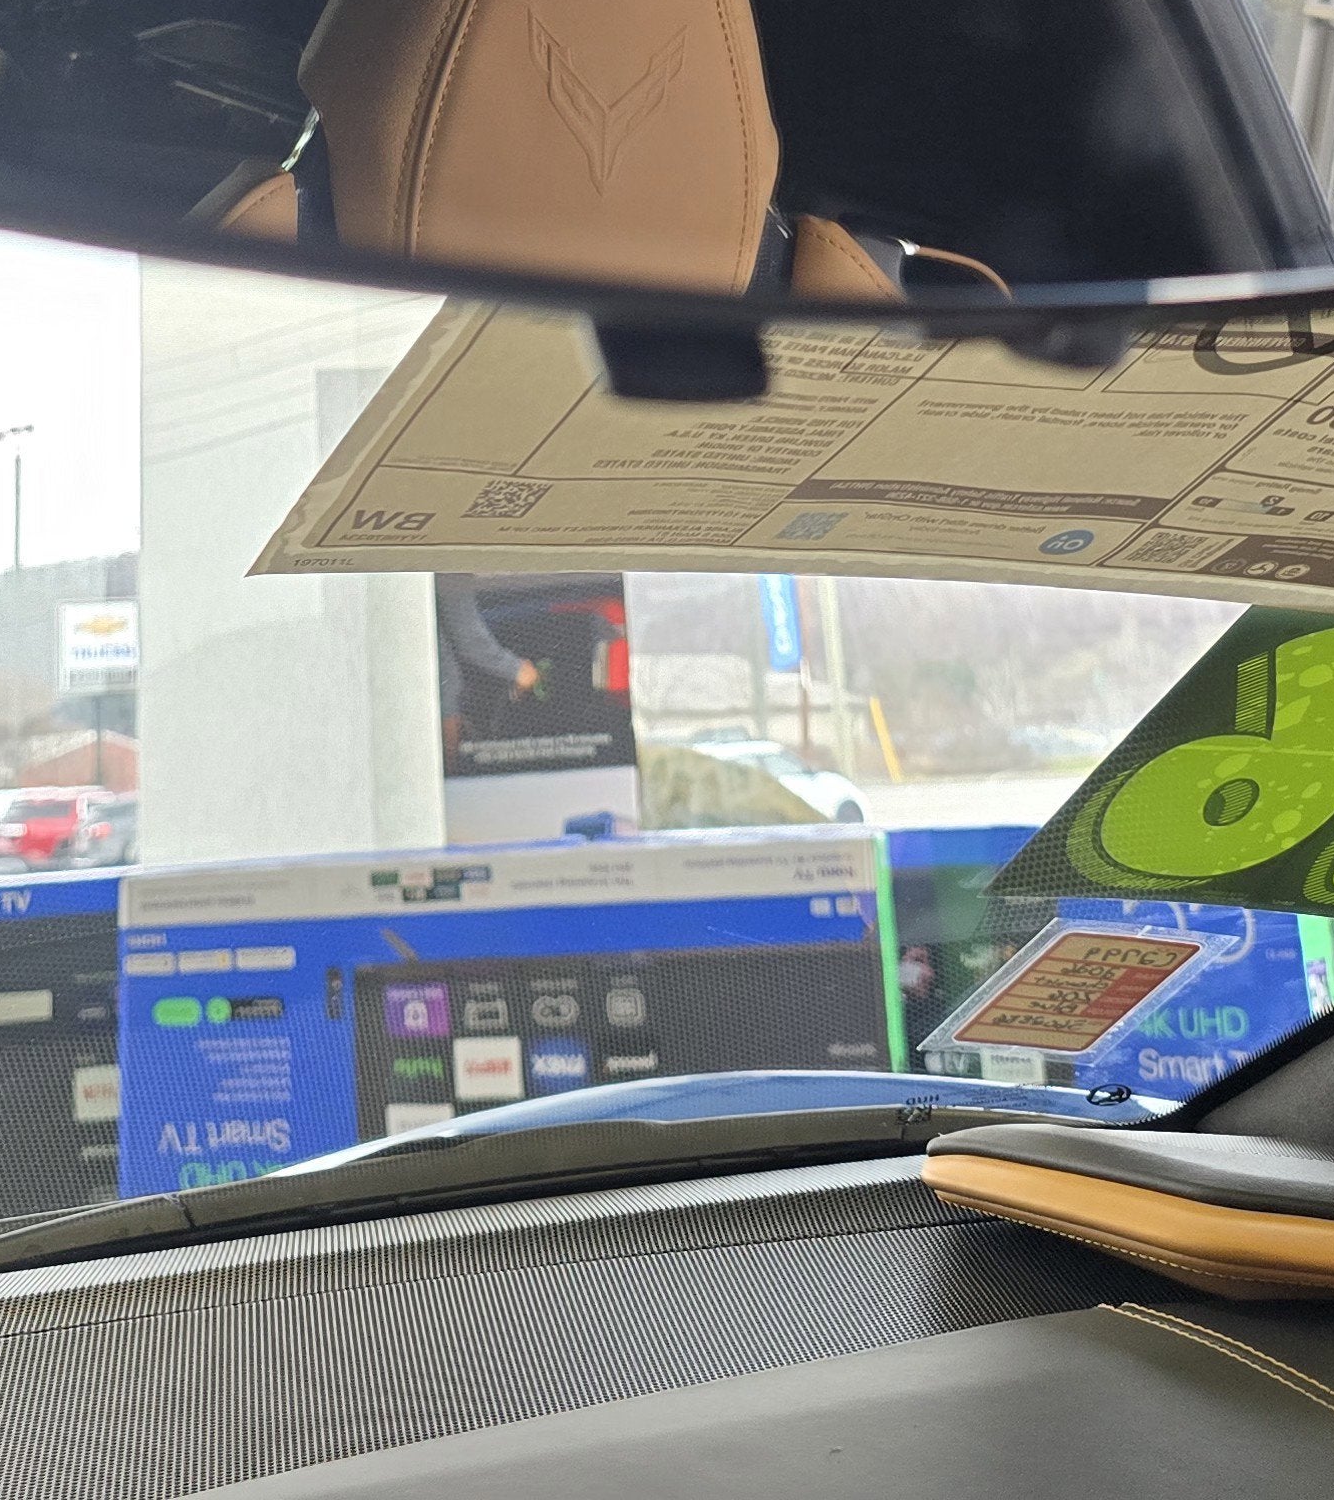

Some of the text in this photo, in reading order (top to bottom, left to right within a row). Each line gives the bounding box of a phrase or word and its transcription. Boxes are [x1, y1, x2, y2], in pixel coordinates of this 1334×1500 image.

[1, 889, 34, 913] TV
[1179, 1005, 1249, 1040] UHD
[156, 1118, 292, 1155] Smart TV
